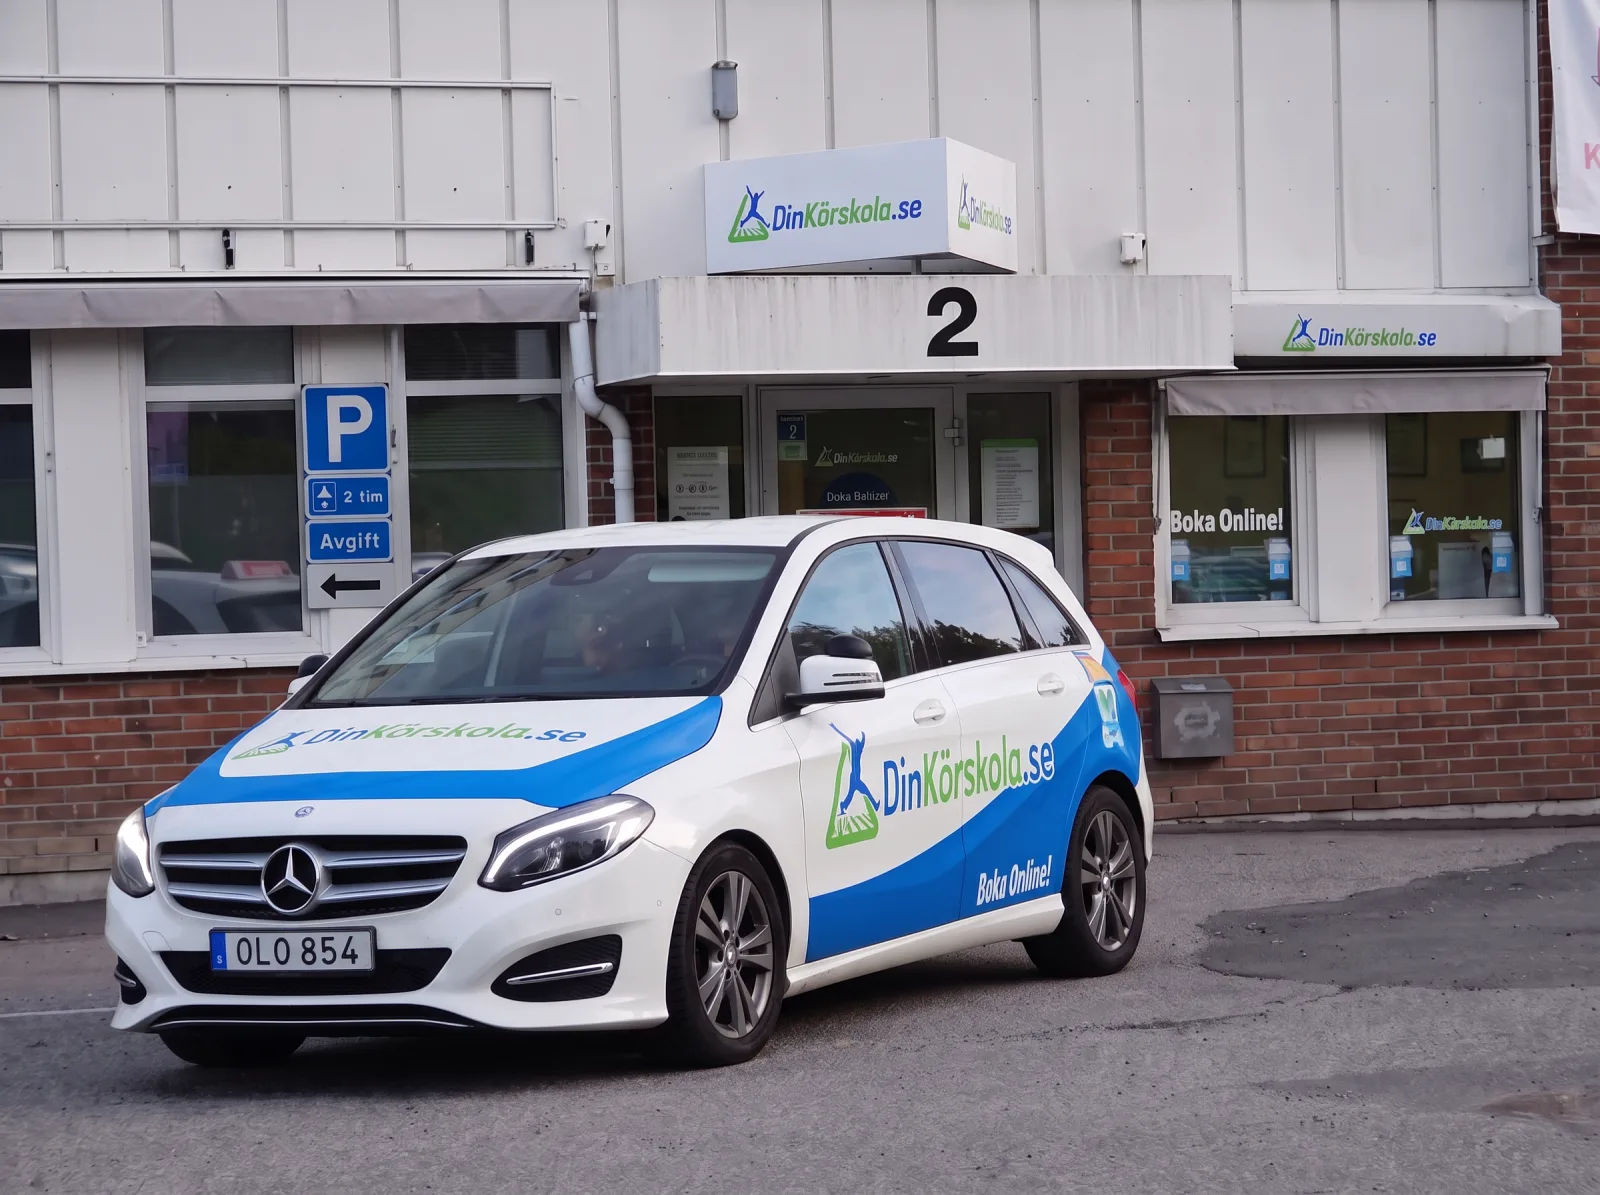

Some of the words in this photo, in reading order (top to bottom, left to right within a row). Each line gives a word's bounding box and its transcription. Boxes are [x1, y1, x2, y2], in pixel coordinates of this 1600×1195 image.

[772, 195, 922, 231] DinKörskola.se
[970, 196, 1012, 235] DinKörskola.se
[927, 286, 979, 357] 2
[1318, 327, 1437, 346] DinKörskola.se
[326, 395, 373, 463] P
[789, 424, 798, 440] 2
[833, 451, 898, 464] DinKörskola.se
[343, 490, 353, 503] 2
[359, 490, 383, 503] tim
[827, 492, 851, 502] Doka
[1170, 509, 1215, 533] Boka
[1219, 507, 1284, 532] Online!
[1425, 516, 1503, 531] DinKörskola.se
[320, 532, 380, 553] Avgift
[303, 722, 587, 746] DinKörskola.se
[883, 735, 1055, 816] DinKörskola.se
[976, 868, 1007, 906] Boka
[1009, 855, 1052, 893] Online!
[216, 955, 223, 964] S
[236, 936, 291, 966] OLO
[301, 935, 359, 966] 854
